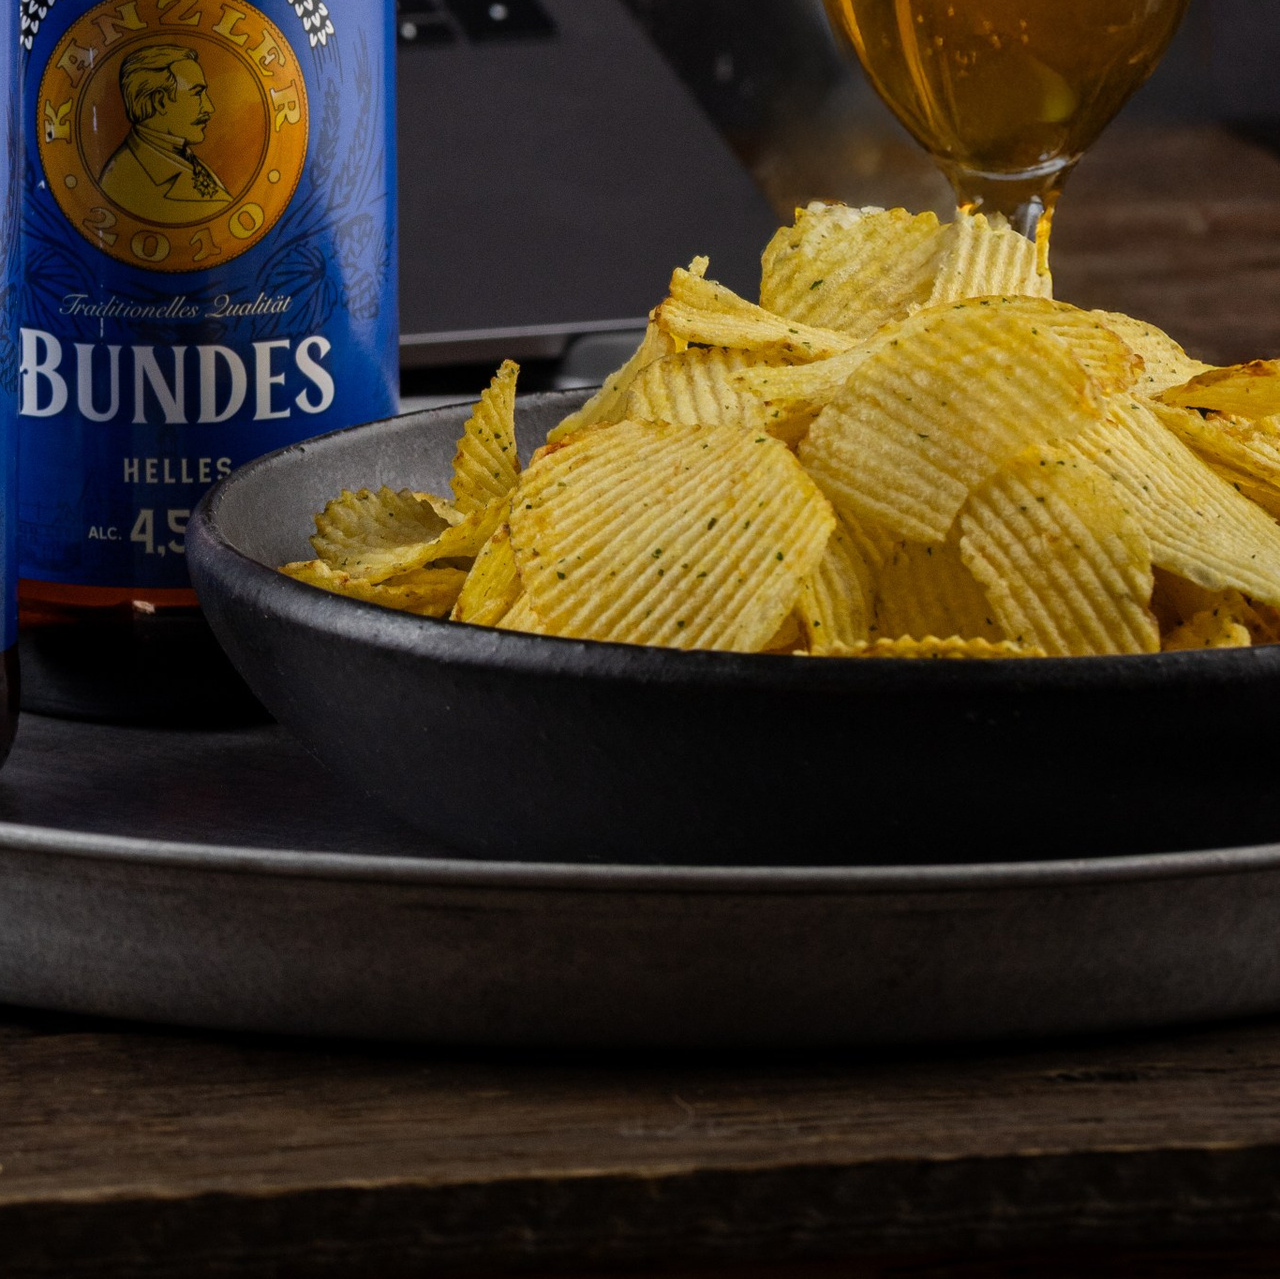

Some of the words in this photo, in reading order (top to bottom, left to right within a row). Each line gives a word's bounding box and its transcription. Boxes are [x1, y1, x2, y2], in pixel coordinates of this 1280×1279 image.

[82, 202, 265, 263] 2010
[59, 293, 200, 318] Traditionelles
[205, 291, 293, 318] Qualität
[19, 327, 336, 424] BUNDES
[123, 457, 233, 484] HELLES
[88, 526, 122, 541] ALC.
[129, 509, 188, 558] 4,5
